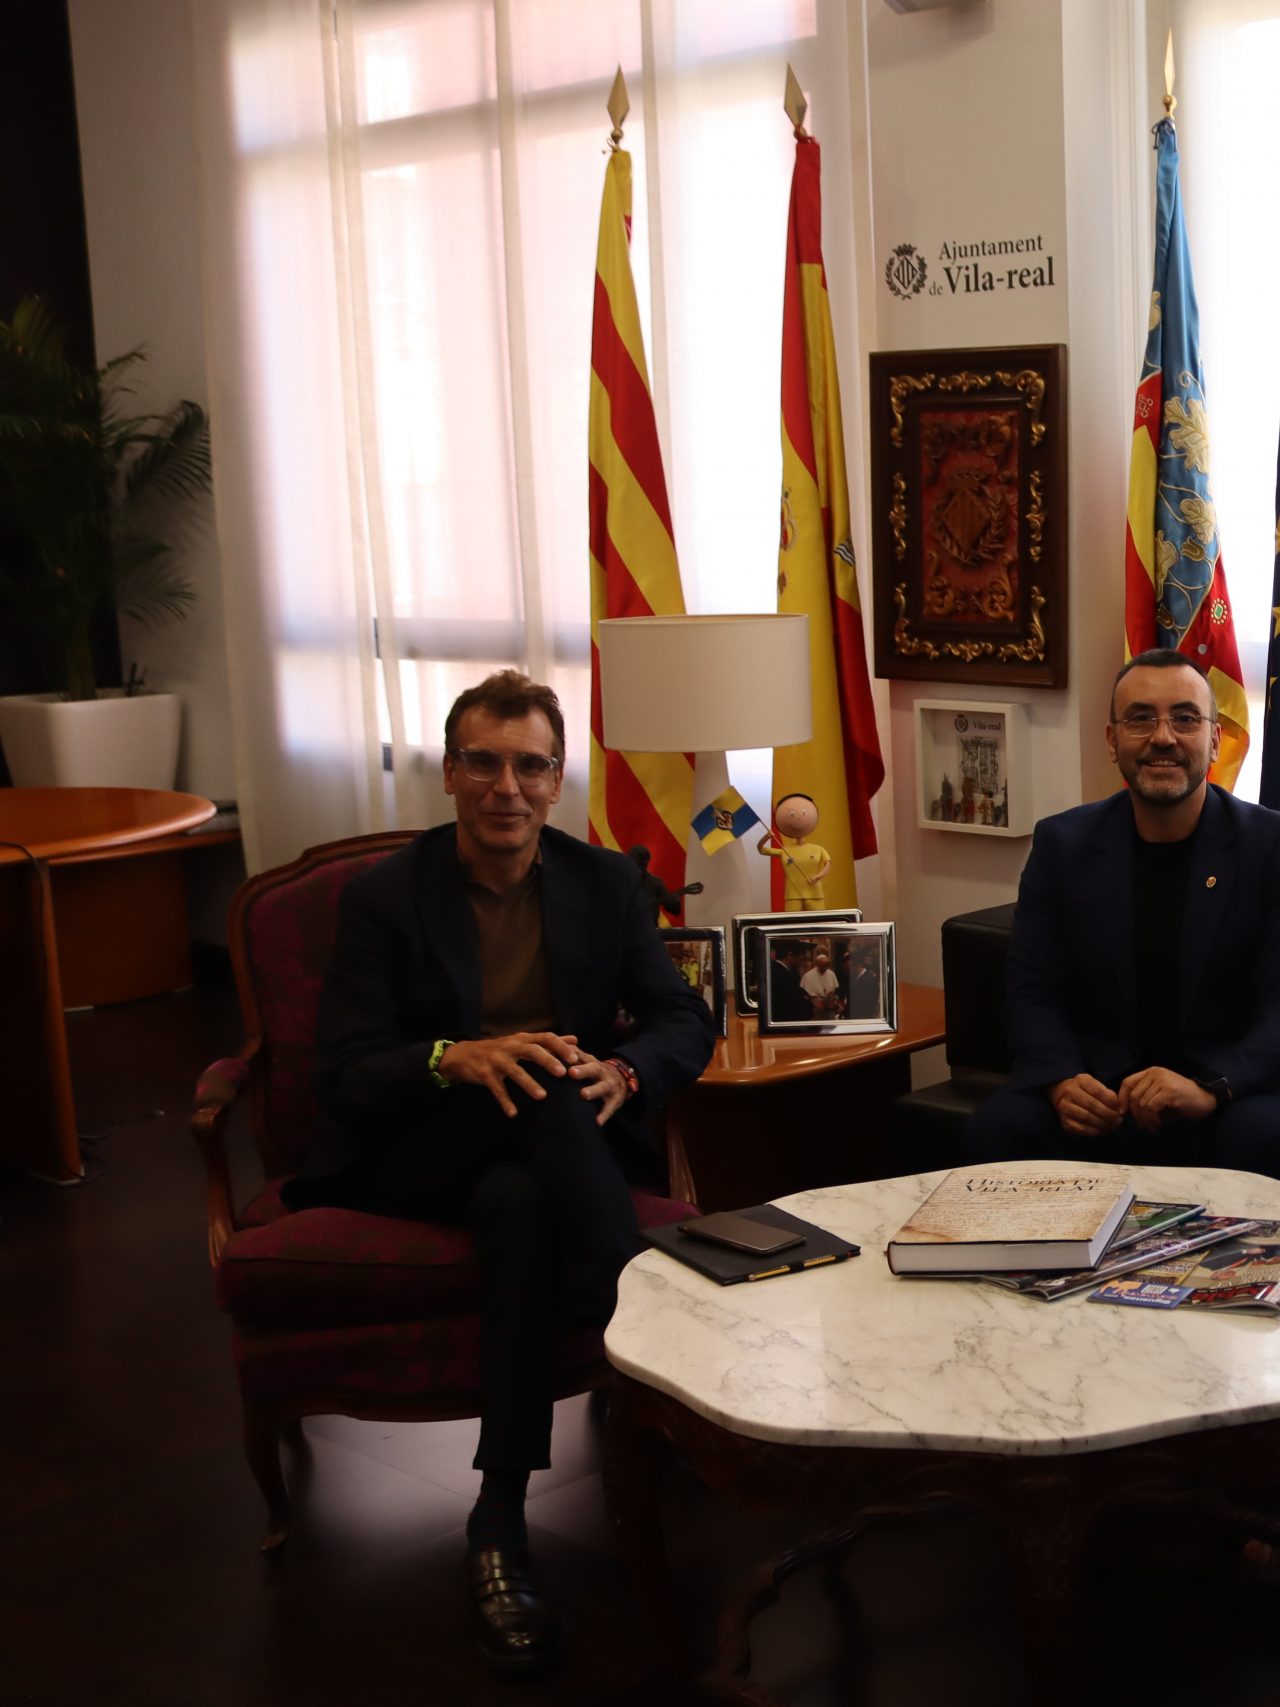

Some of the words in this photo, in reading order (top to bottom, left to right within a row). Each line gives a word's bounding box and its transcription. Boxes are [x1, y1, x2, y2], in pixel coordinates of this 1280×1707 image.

[938, 234, 1043, 266] Ajuntament
[928, 281, 943, 297] de
[943, 255, 1055, 295] Vila-real
